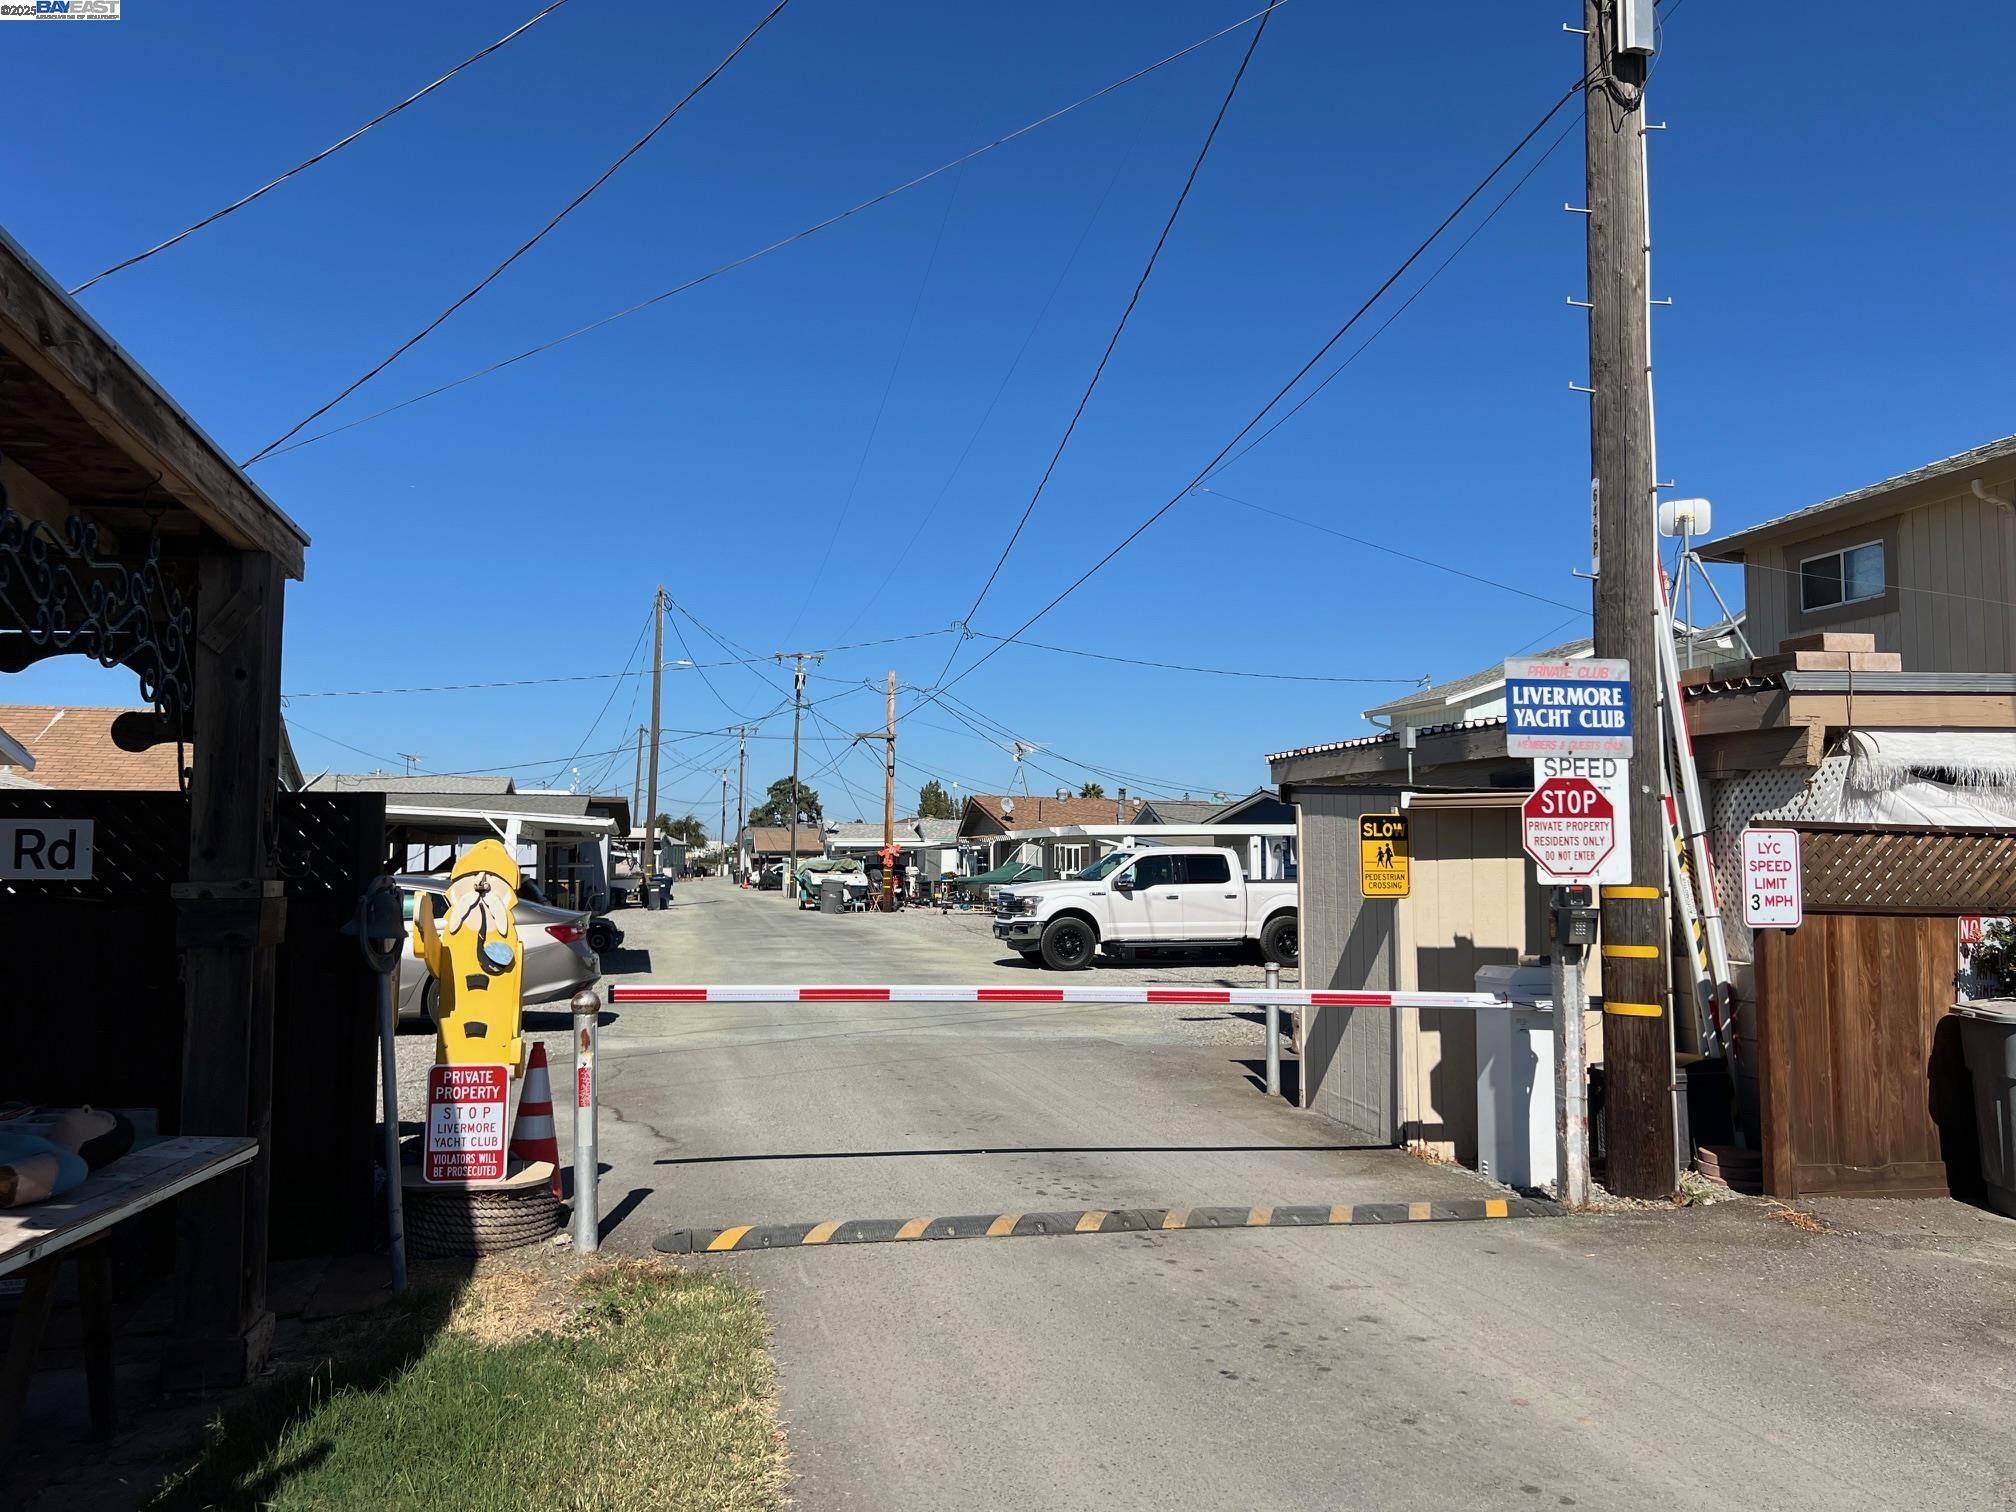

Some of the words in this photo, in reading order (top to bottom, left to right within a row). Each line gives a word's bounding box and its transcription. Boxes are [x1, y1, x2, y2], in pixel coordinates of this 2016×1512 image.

[1528, 666, 1574, 678] PRIVATE
[1577, 666, 1608, 679] CLUB
[1512, 686, 1624, 706] LIVERMORE
[1514, 708, 1572, 728] YACHT
[1580, 709, 1625, 728] CLUB
[1518, 740, 1556, 750] MEMBERS
[1568, 741, 1600, 750] GUESTS
[1604, 742, 1624, 751] ONLY
[1544, 758, 1617, 778] SPEED
[1541, 790, 1597, 814] STOP
[1362, 822, 1405, 838] SLOW
[1528, 822, 1562, 832] PRIVATE
[1566, 822, 1610, 832] PROPERTY
[1534, 836, 1580, 846] RESIDENTS
[1583, 836, 1606, 846] ONLY
[14, 828, 77, 870] Rd
[1758, 842, 1782, 854] LYC
[1546, 850, 1554, 860] DO
[1558, 850, 1571, 860] NOT
[1574, 850, 1596, 860] ENTER
[1750, 860, 1792, 872] SPEED
[1754, 878, 1787, 890] LIMIT
[1751, 894, 1760, 911] 3
[1764, 895, 1793, 908] MPH
[444, 1070, 494, 1084] PRIVATE
[436, 1086, 500, 1100] PROPERTY
[444, 1106, 491, 1120] STOP
[438, 1122, 496, 1134] LIVERMORE
[434, 1137, 466, 1148] YACHT
[470, 1136, 498, 1146] CLUB
[433, 1153, 476, 1164] VIOLATORS
[478, 1153, 498, 1164] WILL
[433, 1166, 444, 1177] BE
[447, 1166, 497, 1176] PROSECUTED
